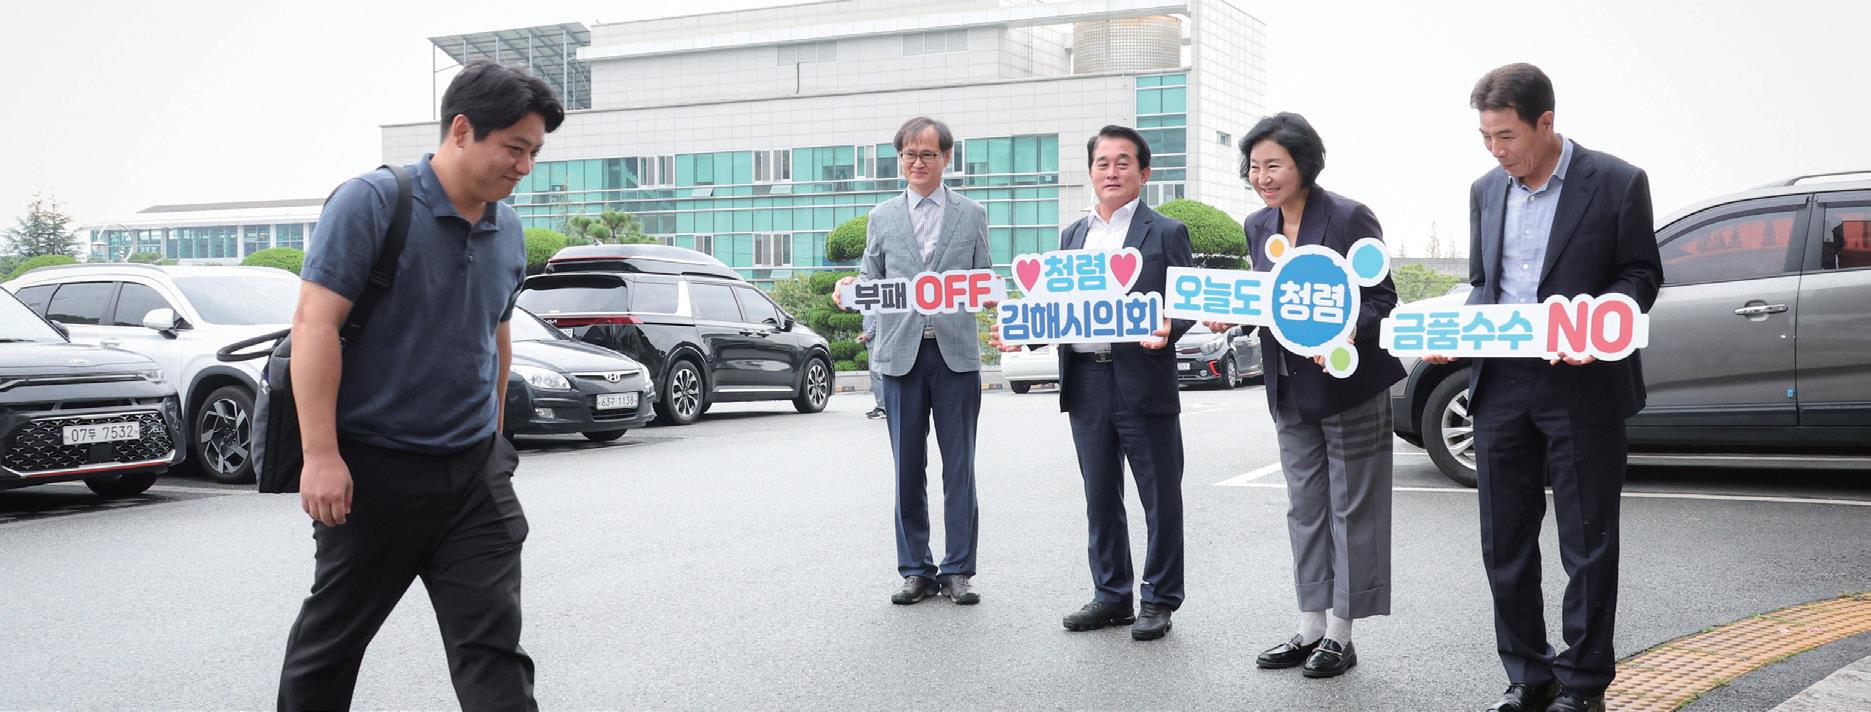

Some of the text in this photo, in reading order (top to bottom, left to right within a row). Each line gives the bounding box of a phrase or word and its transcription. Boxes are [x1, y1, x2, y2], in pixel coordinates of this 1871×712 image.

[855, 273, 992, 311] 부패 OFF
[1044, 252, 1107, 293] 청렴
[1001, 297, 1158, 341] 김해시의회
[1174, 275, 1345, 324] 오늘도 청렴
[1393, 300, 1634, 354] 금품수수 NO
[71, 424, 134, 442] 07두 7532
